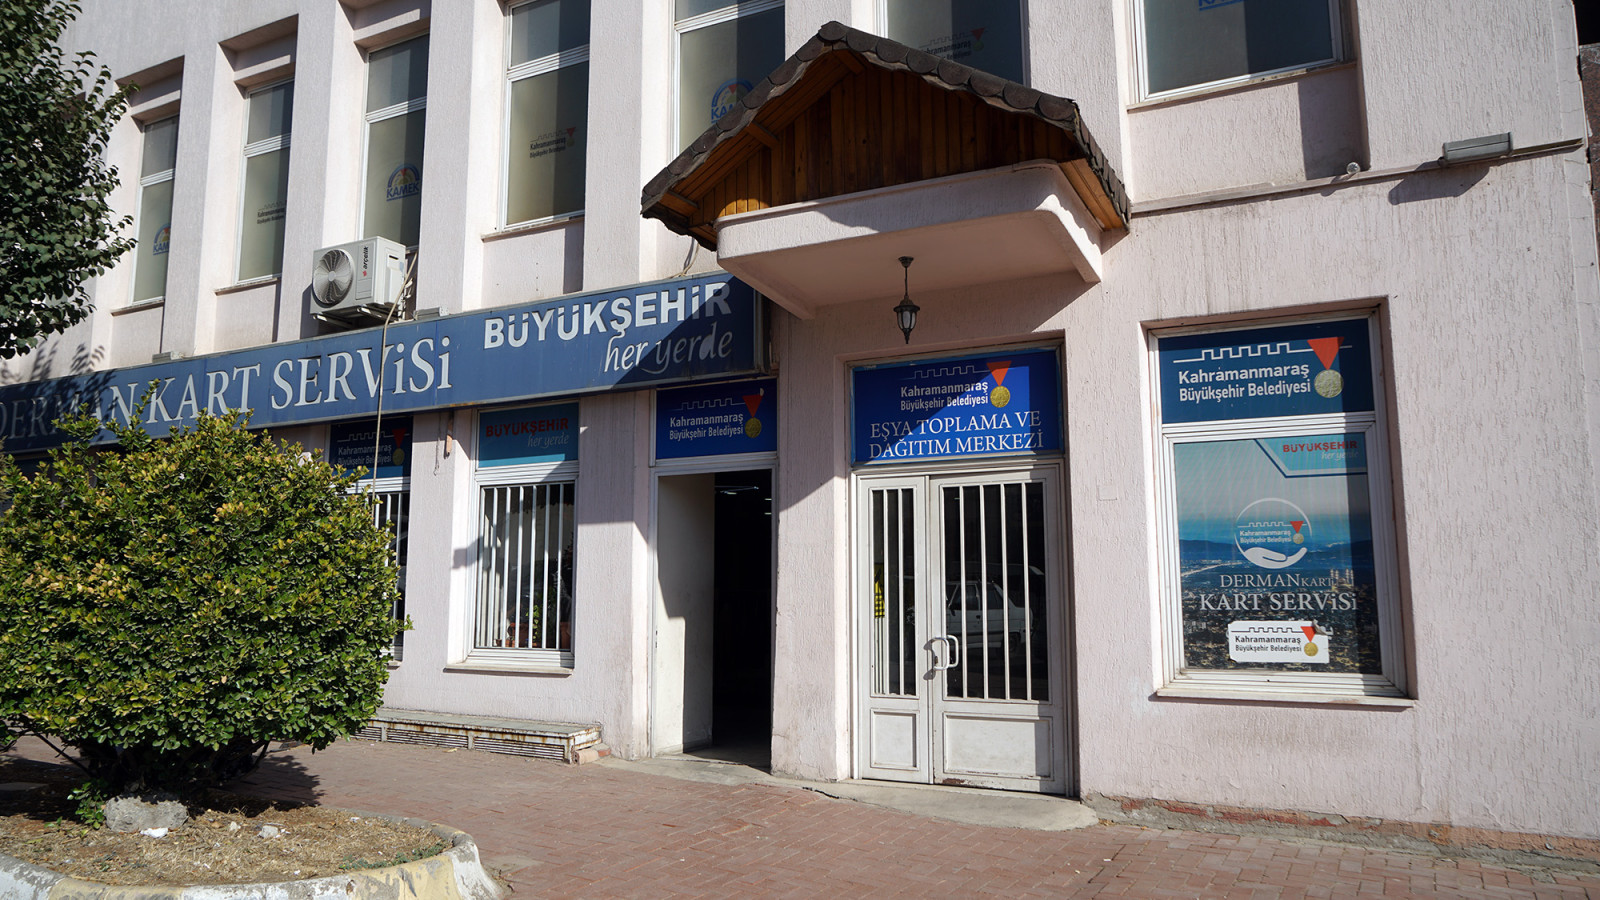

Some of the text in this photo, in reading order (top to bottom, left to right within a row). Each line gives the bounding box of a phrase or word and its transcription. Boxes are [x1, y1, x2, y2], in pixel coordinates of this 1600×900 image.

[386, 182, 420, 199] KAMEK
[604, 321, 733, 375] her yerde
[1179, 363, 1310, 385] Kahramanmaraş
[146, 363, 261, 424] KART
[900, 381, 989, 398] Kahramanmaraş
[1179, 379, 1311, 404] Büyükşehir Belediyesi
[900, 392, 989, 413] Büyükşehir Belediyesi
[670, 413, 744, 428] Kahramanmaraş
[870, 410, 1042, 443] EŞYA TOPLAMA VE
[527, 431, 569, 449] her yerde
[669, 423, 744, 442] Büyükşehir Belediyesi
[869, 429, 1044, 459] DAĞITIM MERKEZİ
[1200, 594, 1264, 611] KART
[1235, 635, 1301, 645] Kahramanmaraş
[1235, 644, 1302, 653] Büyükşehir Belediyesi
